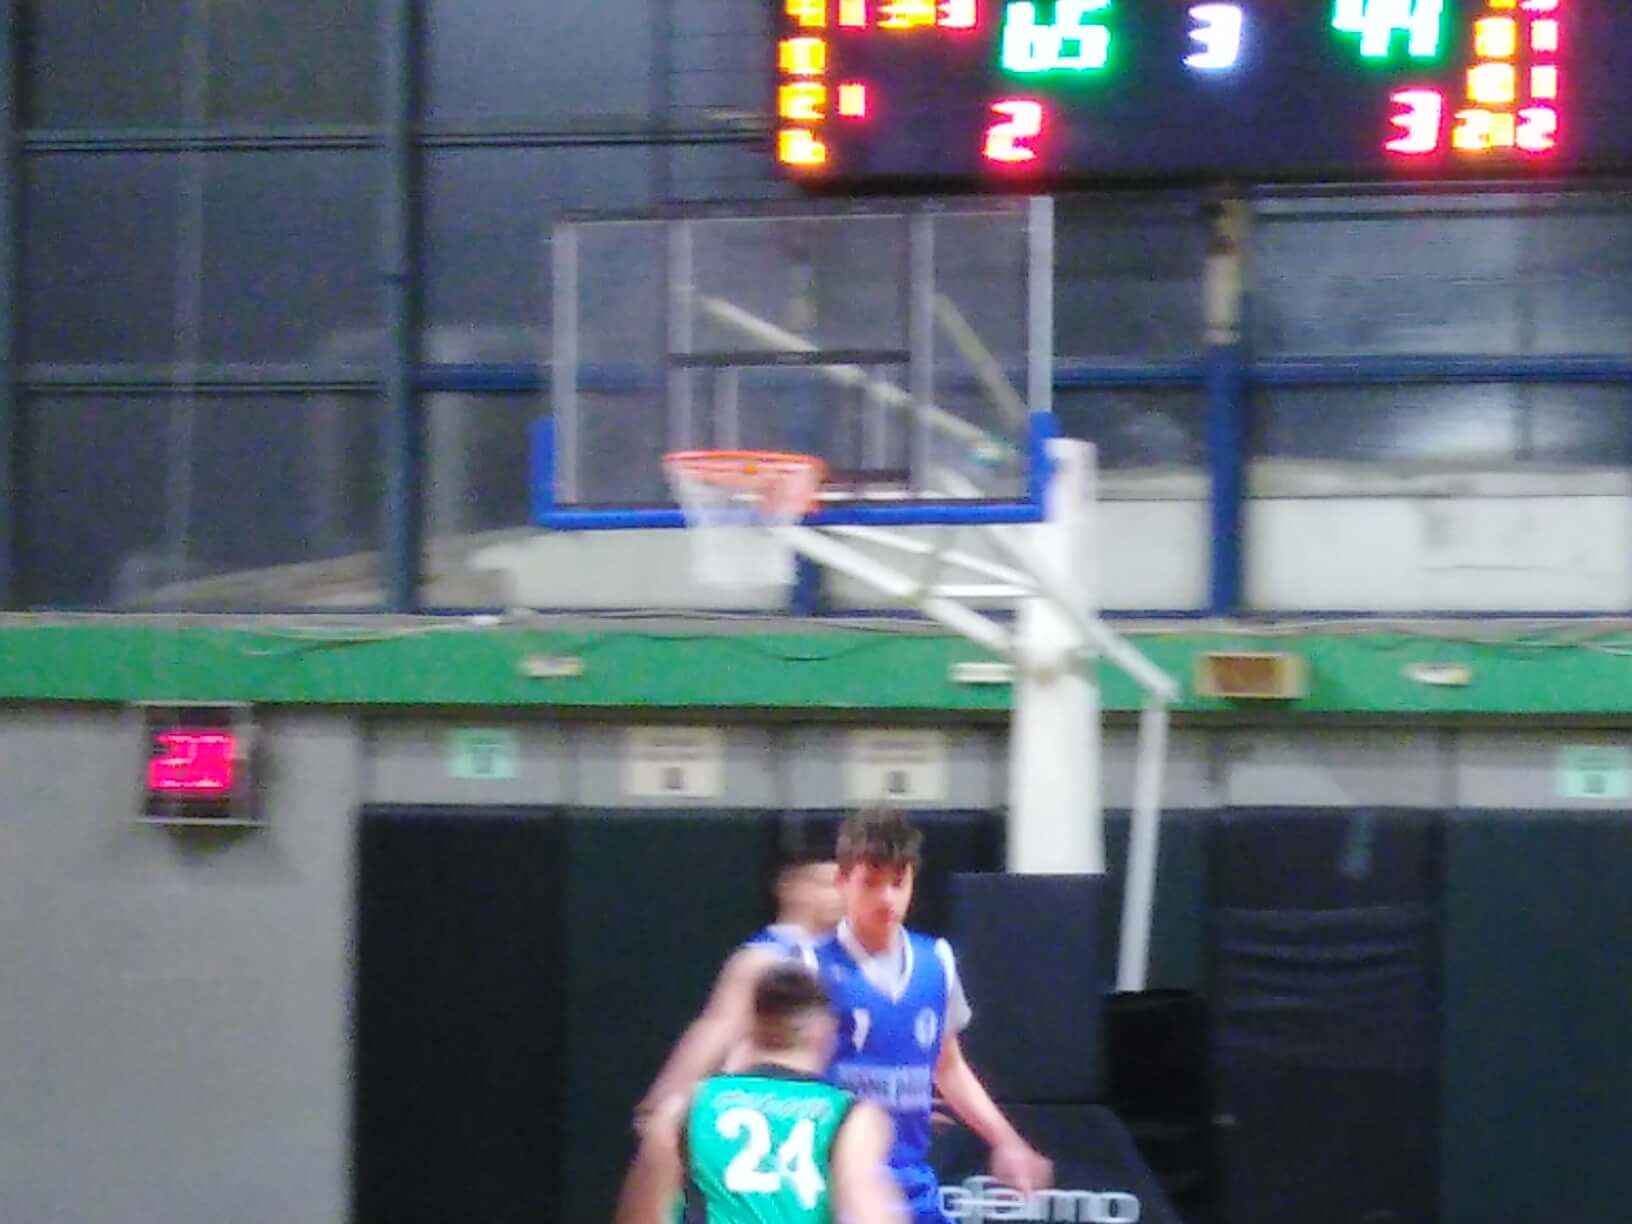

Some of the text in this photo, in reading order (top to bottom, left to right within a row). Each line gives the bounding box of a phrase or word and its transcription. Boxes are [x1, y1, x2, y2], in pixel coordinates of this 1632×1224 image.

[1184, 4, 1242, 68] 3
[984, 100, 1043, 162] 2
[1385, 90, 1443, 153] 3
[714, 1106, 827, 1211] 24
